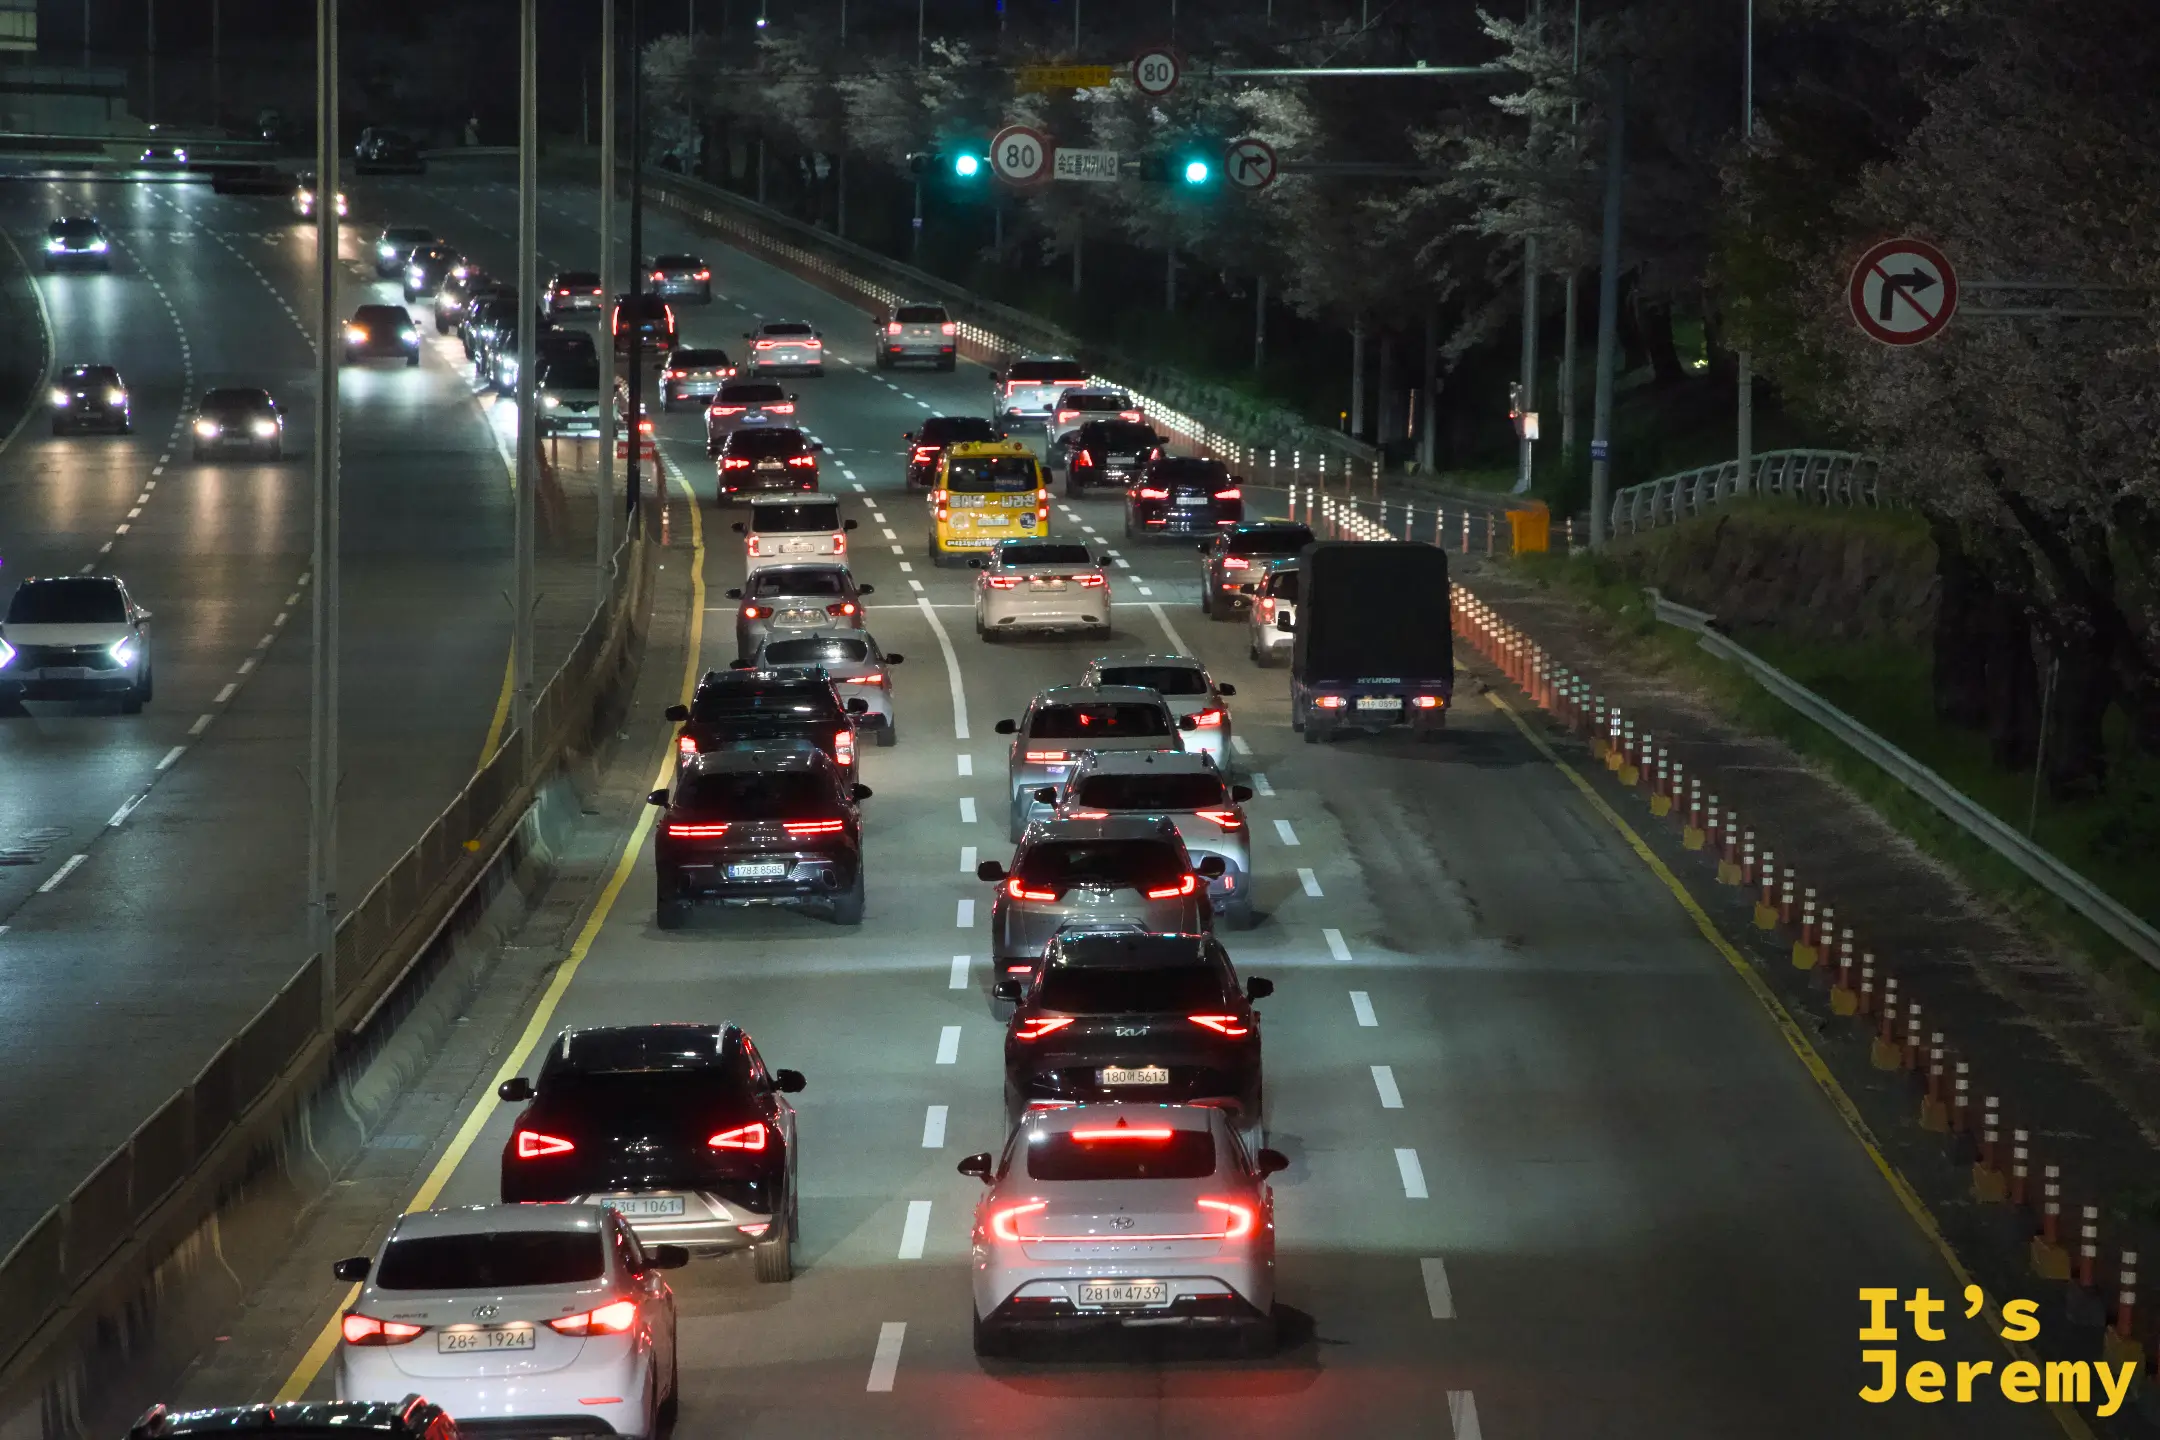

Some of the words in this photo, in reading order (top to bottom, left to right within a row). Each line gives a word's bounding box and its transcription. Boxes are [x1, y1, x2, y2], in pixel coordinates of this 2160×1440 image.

[1143, 62, 1169, 82] 80
[1005, 144, 1035, 169] 80
[1137, 1070, 1167, 1082] 5613
[642, 1200, 675, 1213] 1061
[1125, 1286, 1161, 1300] 4739
[447, 1333, 479, 1350] 28수
[487, 1331, 526, 1348] 1924
